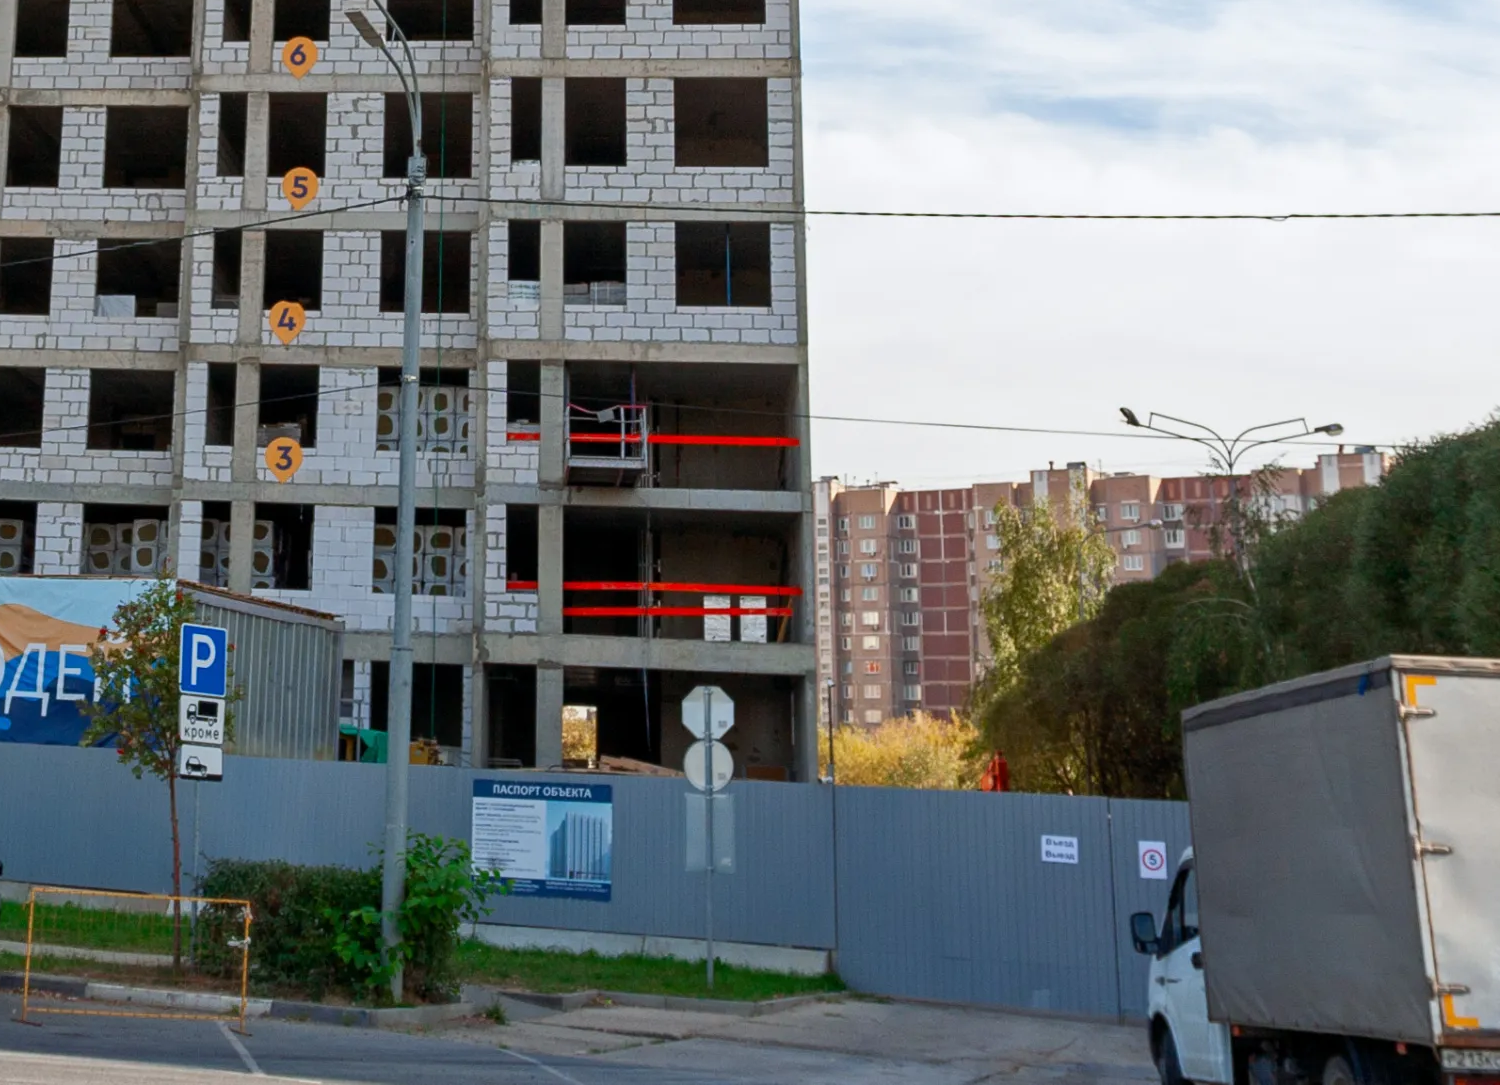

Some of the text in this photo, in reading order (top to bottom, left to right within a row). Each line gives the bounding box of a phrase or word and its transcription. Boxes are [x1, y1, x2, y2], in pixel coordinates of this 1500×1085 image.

[290, 44, 307, 66] 6
[291, 176, 308, 199] 5
[277, 307, 297, 331] 4
[275, 446, 293, 471] 3
[190, 633, 216, 685] P
[184, 725, 220, 740] кроме
[493, 783, 592, 799] ПАСПОРТ ОБЪЕКТА
[1149, 854, 1157, 866] 5
